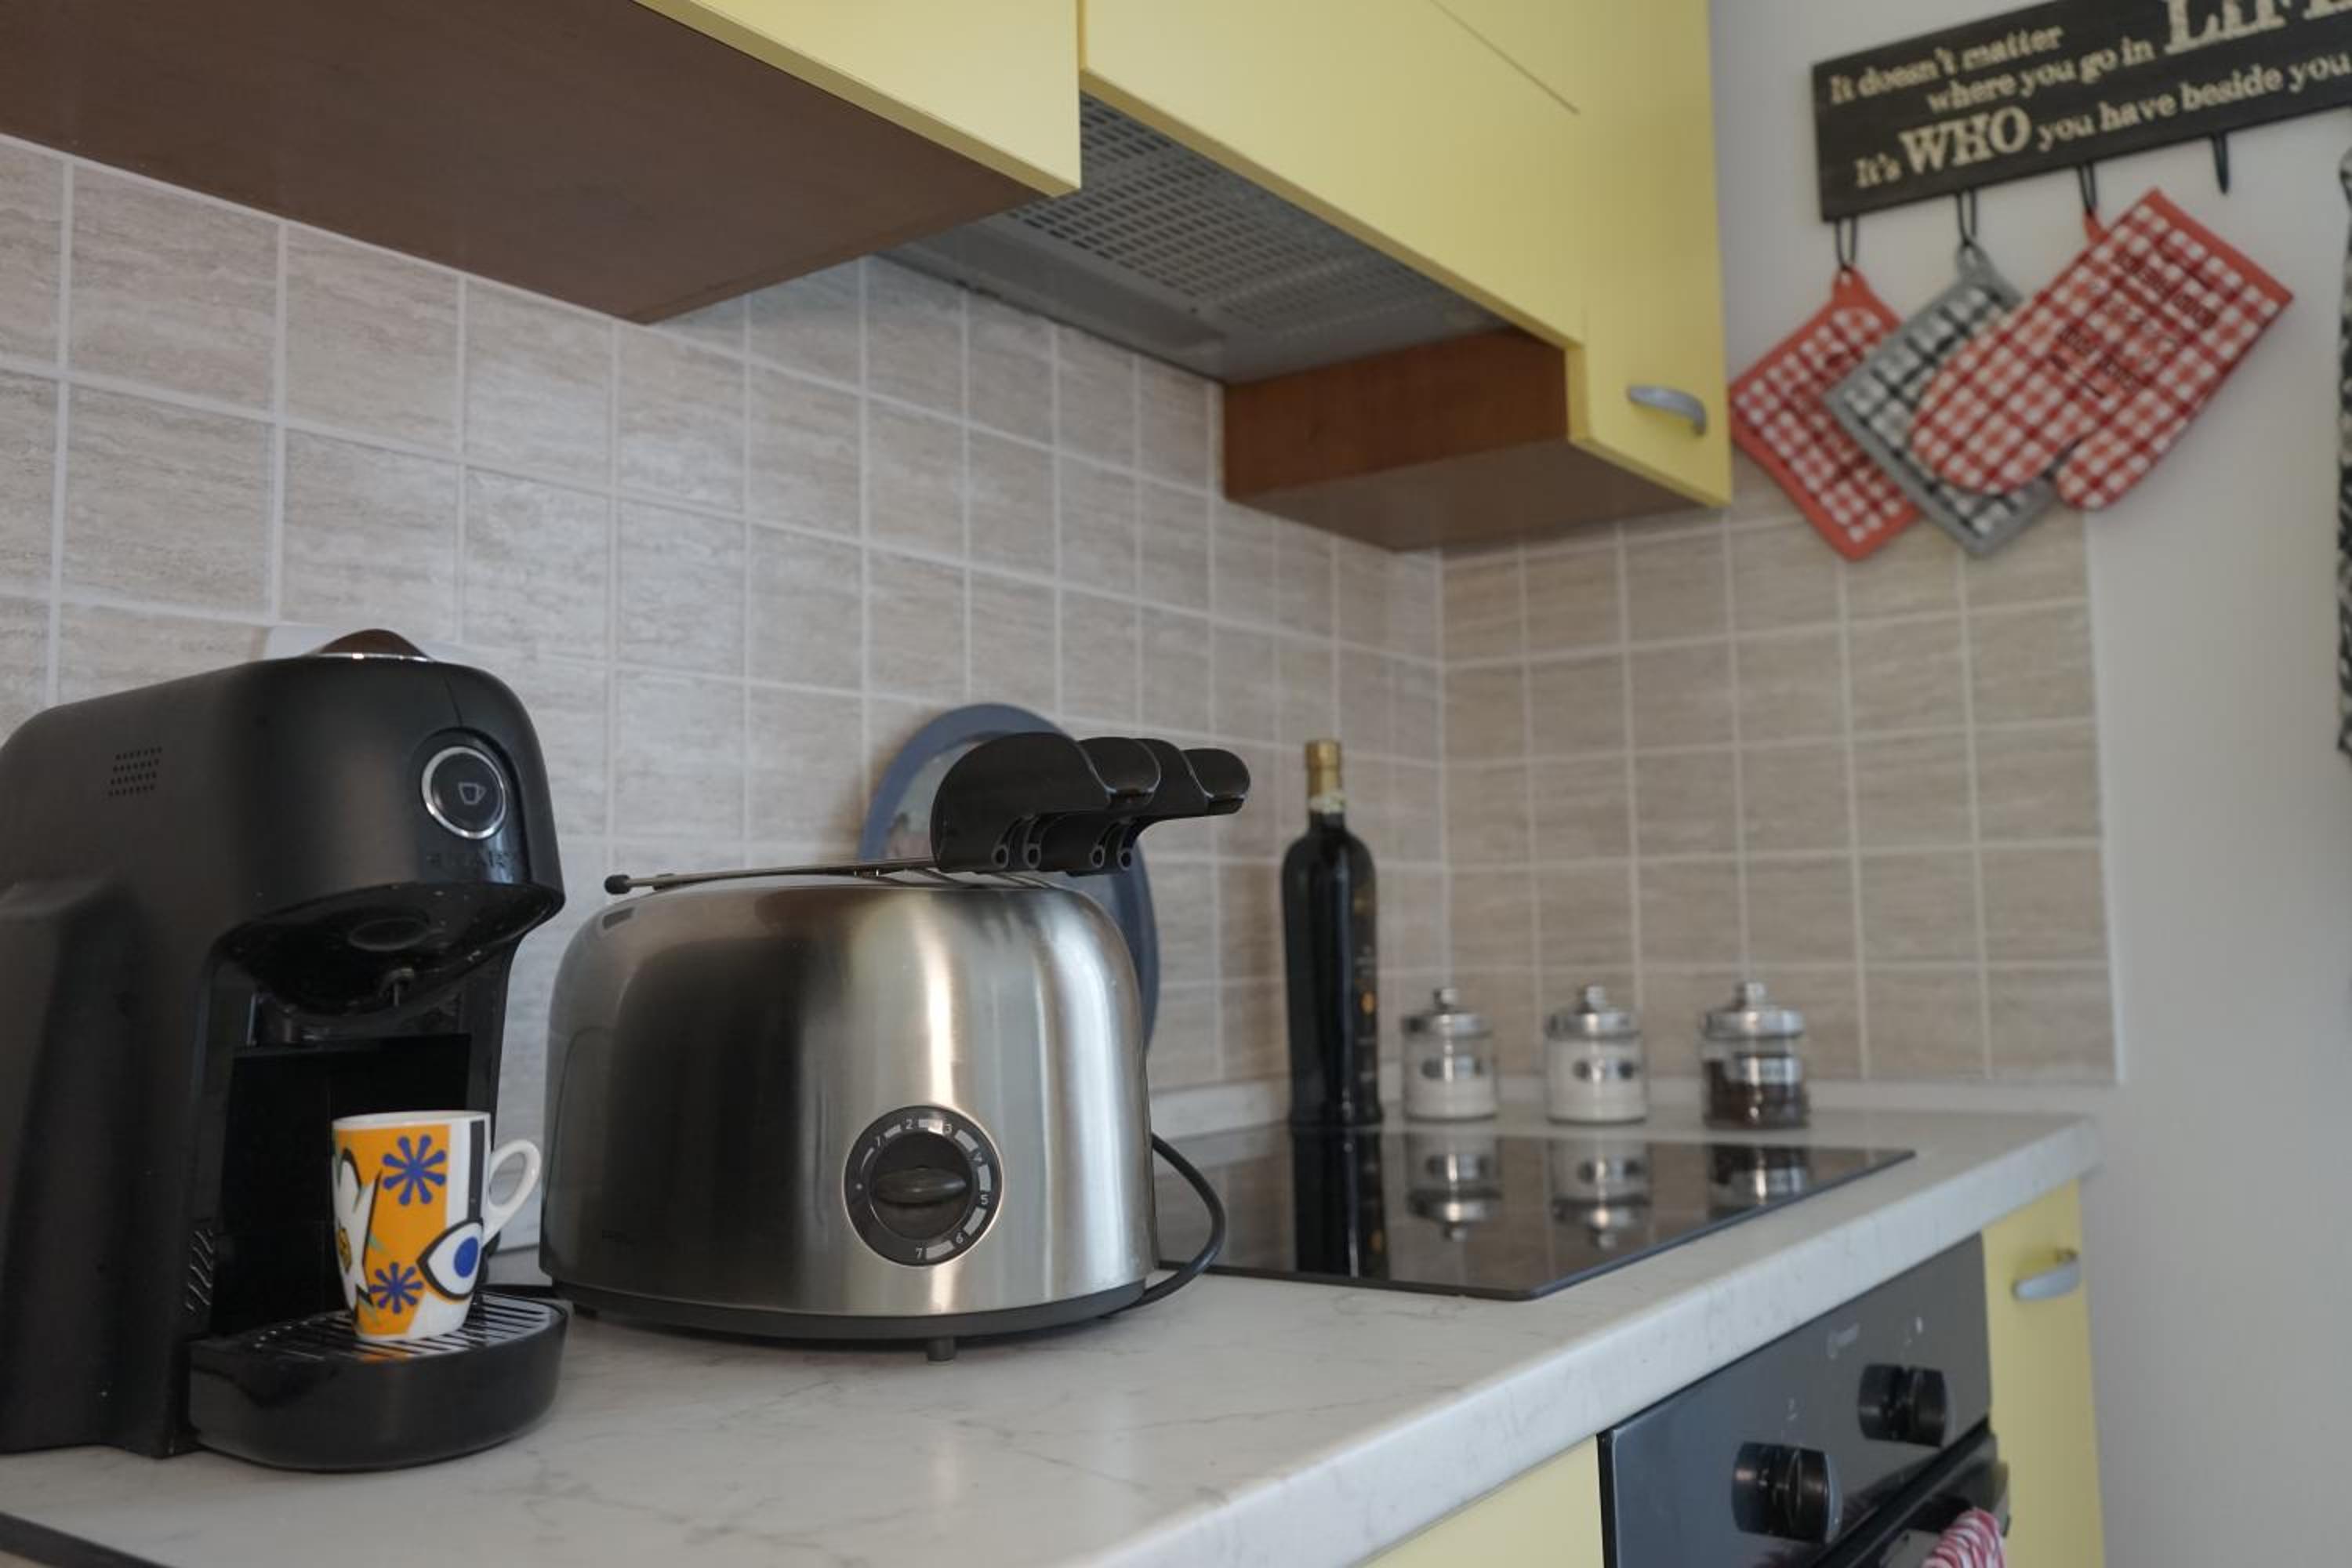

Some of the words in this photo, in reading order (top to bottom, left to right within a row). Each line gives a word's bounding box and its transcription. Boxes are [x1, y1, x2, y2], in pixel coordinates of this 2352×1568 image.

[1831, 75, 1856, 104] It
[1858, 47, 1956, 97] doesn't
[1962, 26, 2063, 71] matter
[1927, 74, 2016, 113] where
[2020, 60, 2076, 98] you
[2082, 49, 2118, 84] go
[2122, 35, 2155, 66] in
[1855, 152, 1901, 188] It's
[1898, 106, 2031, 175] WHO
[2038, 115, 2096, 152] you
[2098, 93, 2176, 132] have
[2180, 63, 2283, 111] beside
[2288, 53, 2352, 93] you
[906, 1119, 913, 1130] 2
[946, 1123, 953, 1134] 3
[980, 1195, 988, 1205] 5
[956, 1233, 964, 1244] 6
[915, 1248, 923, 1259] 7
